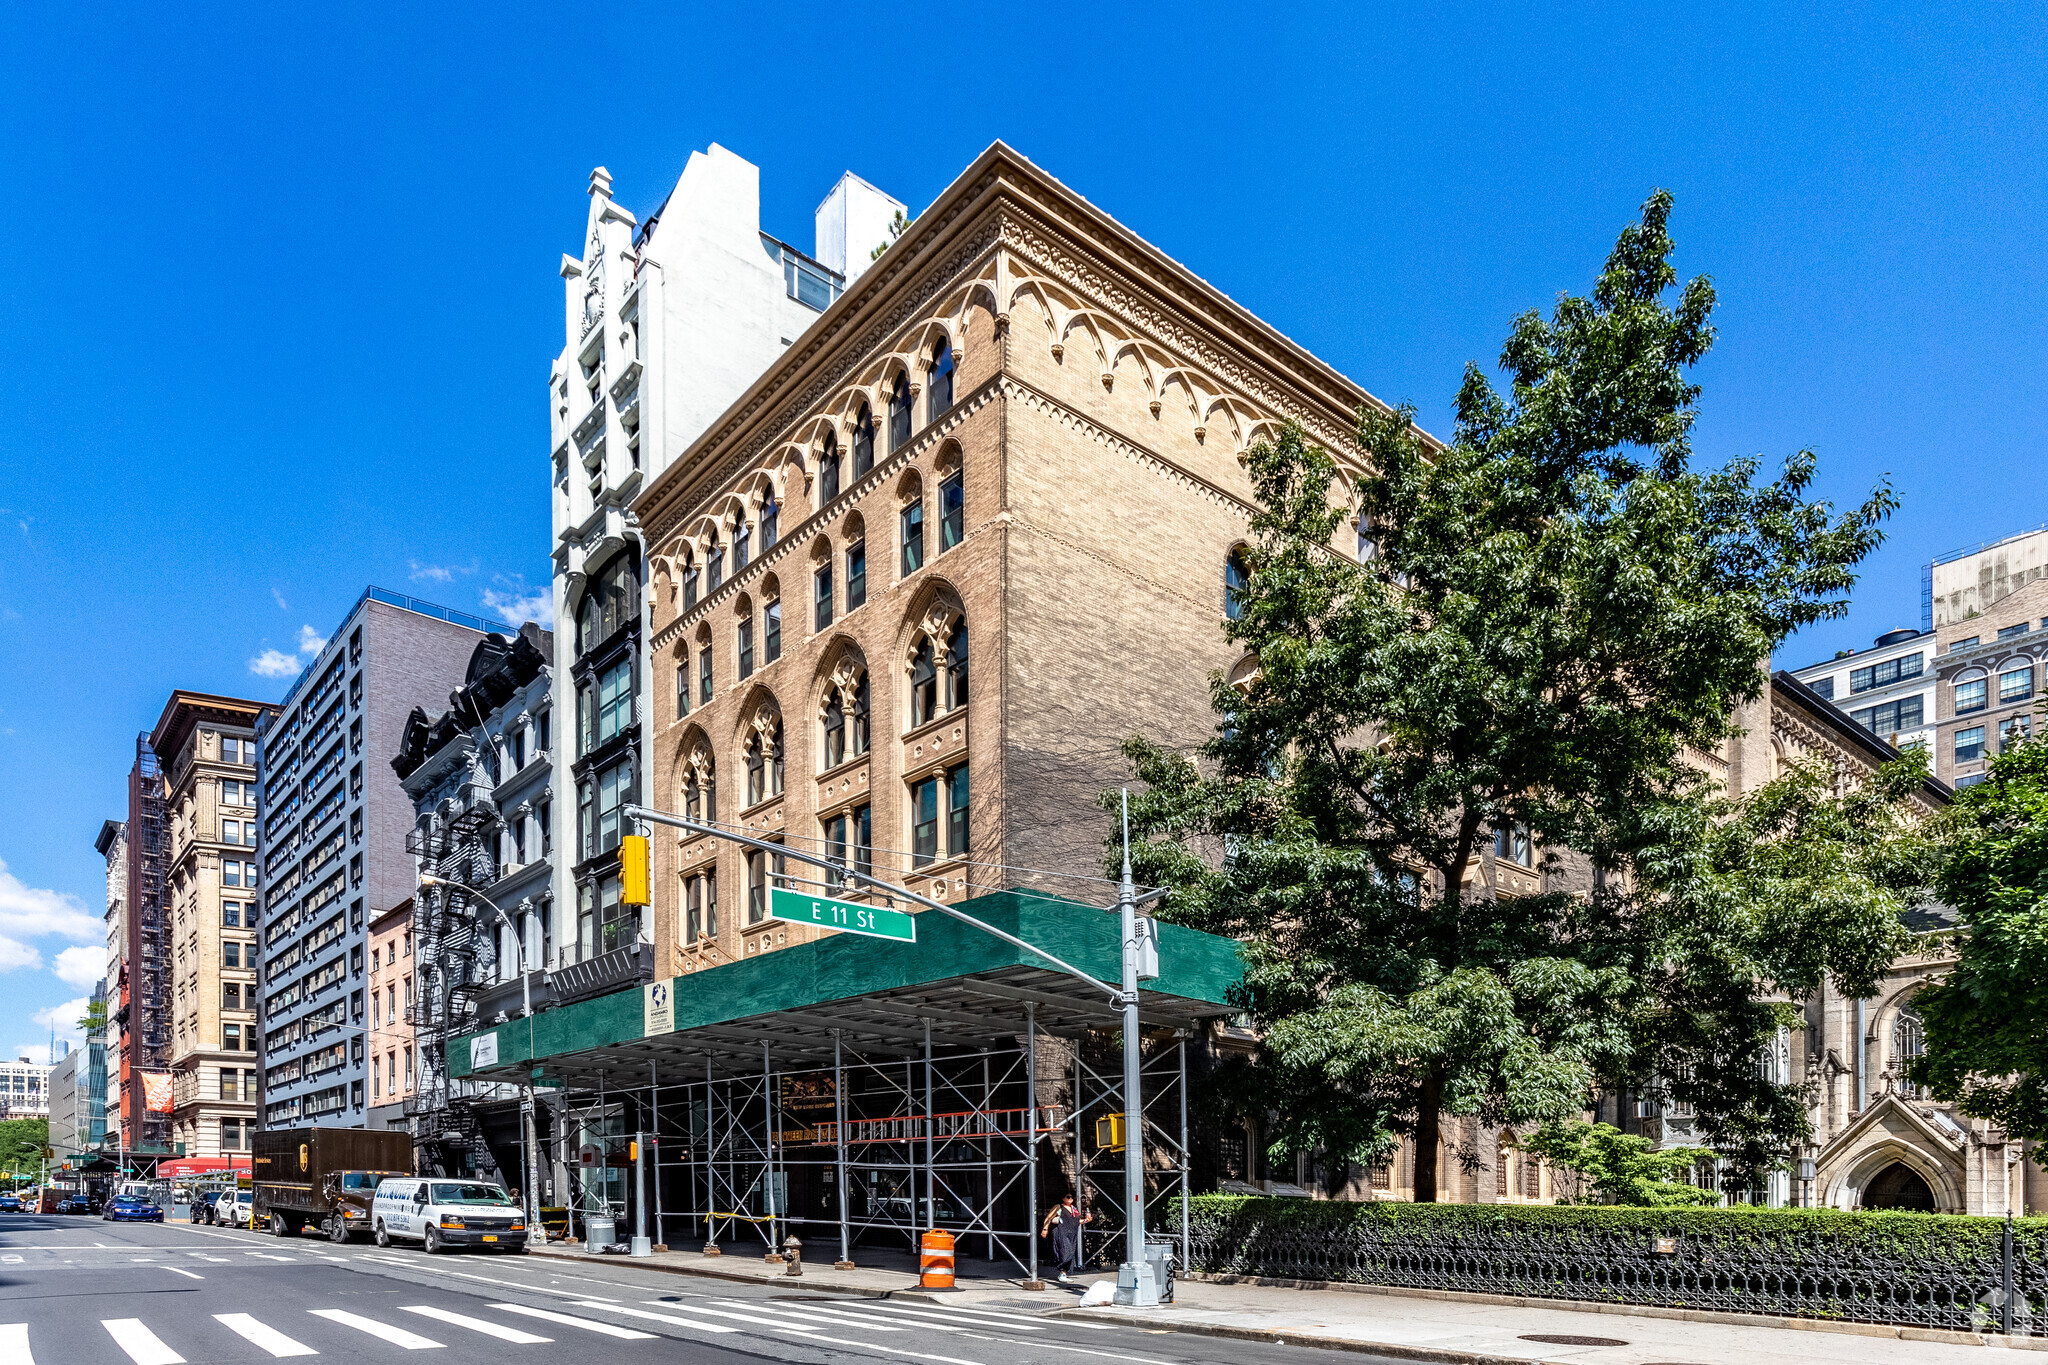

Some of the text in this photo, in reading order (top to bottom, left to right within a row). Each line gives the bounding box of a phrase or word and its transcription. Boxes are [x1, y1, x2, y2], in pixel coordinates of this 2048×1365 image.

[812, 902, 875, 930] E 11 St
[147, 1075, 172, 1101] STRAND
[152, 1087, 173, 1110] BOOKS
